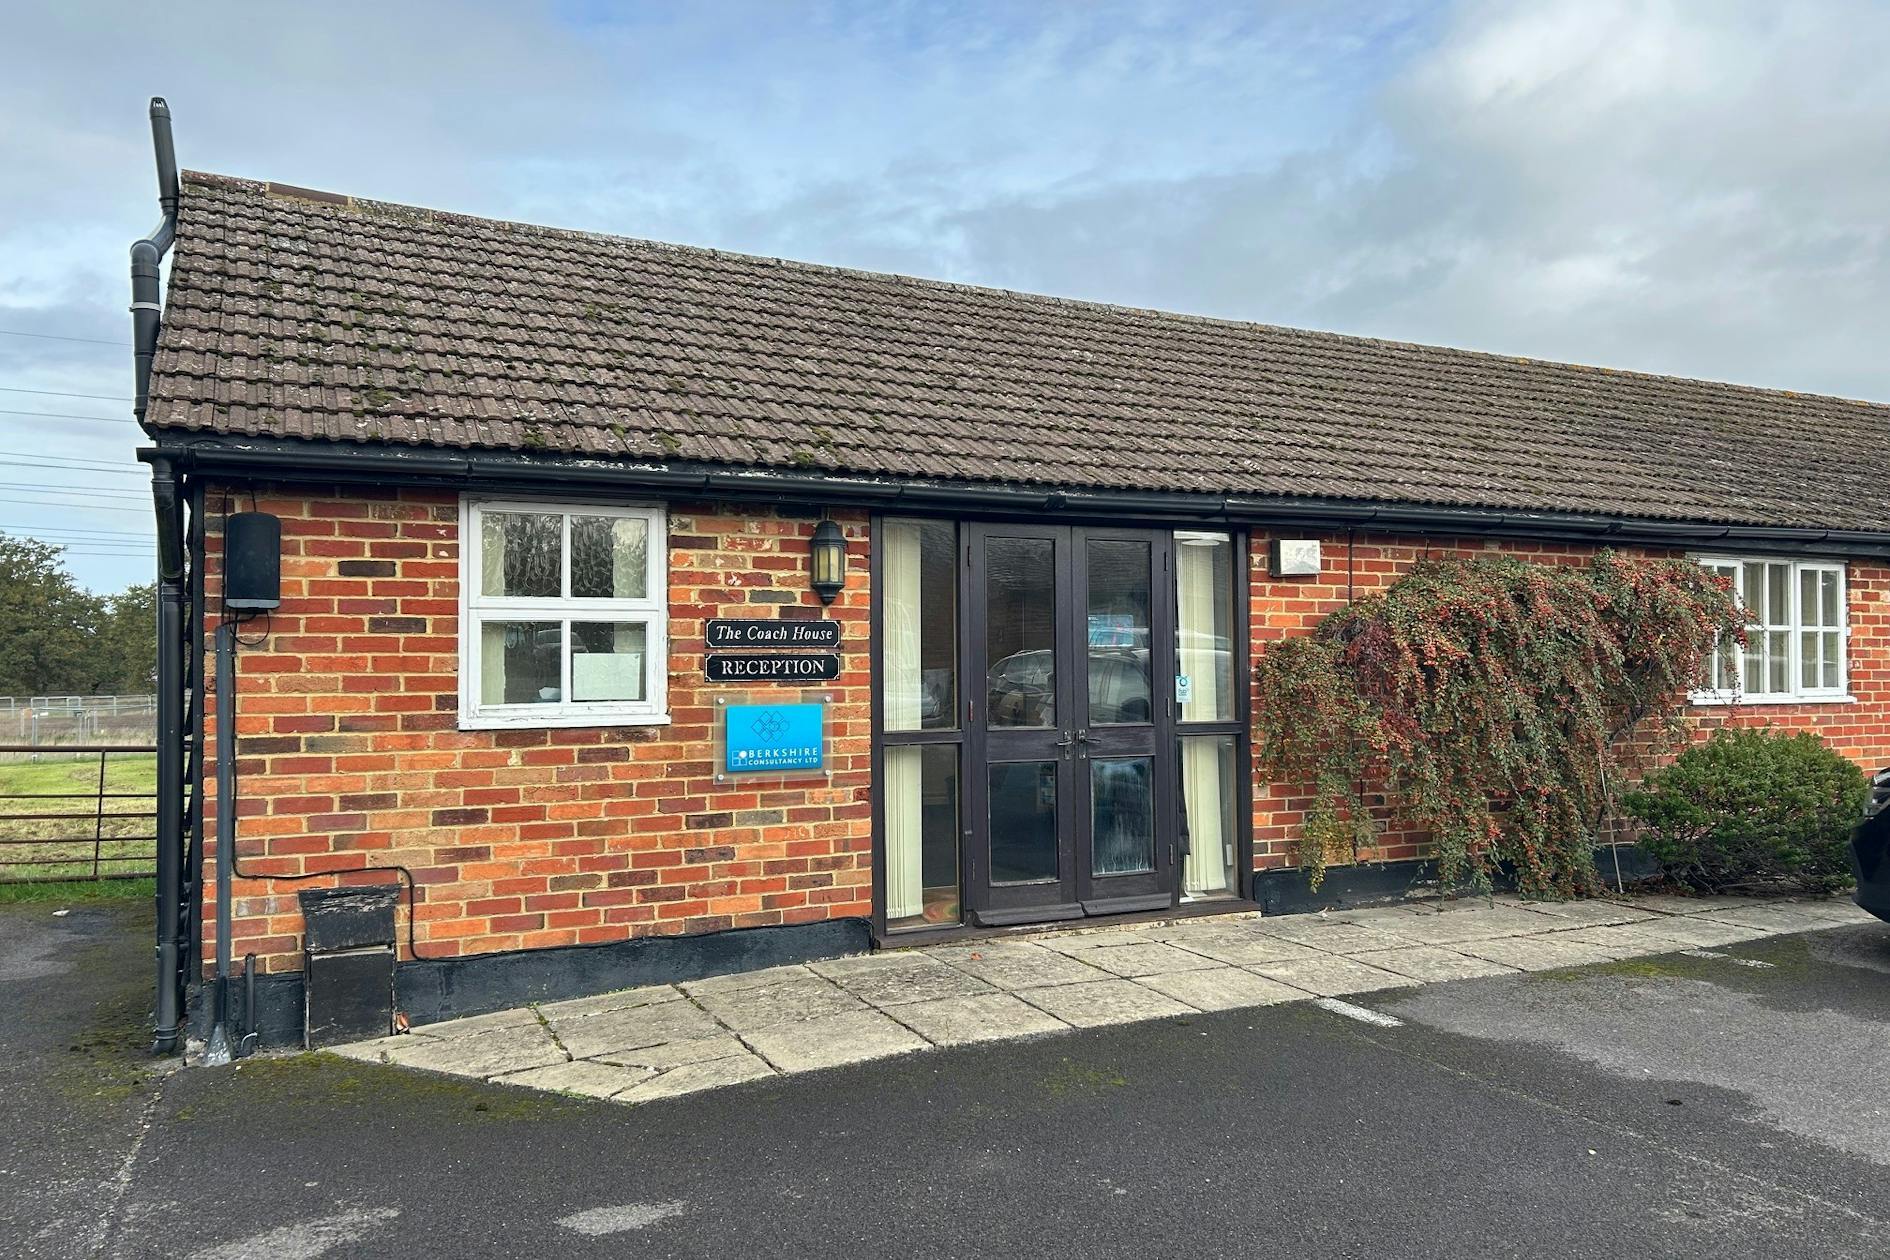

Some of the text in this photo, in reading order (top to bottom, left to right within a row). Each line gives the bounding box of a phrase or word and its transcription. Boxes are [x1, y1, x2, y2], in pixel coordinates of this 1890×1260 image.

[716, 625, 833, 640] The Coach House
[721, 659, 825, 675] RECEPTION
[748, 747, 818, 758] BERKSHIRE
[748, 757, 802, 766] CONSULTANCY
